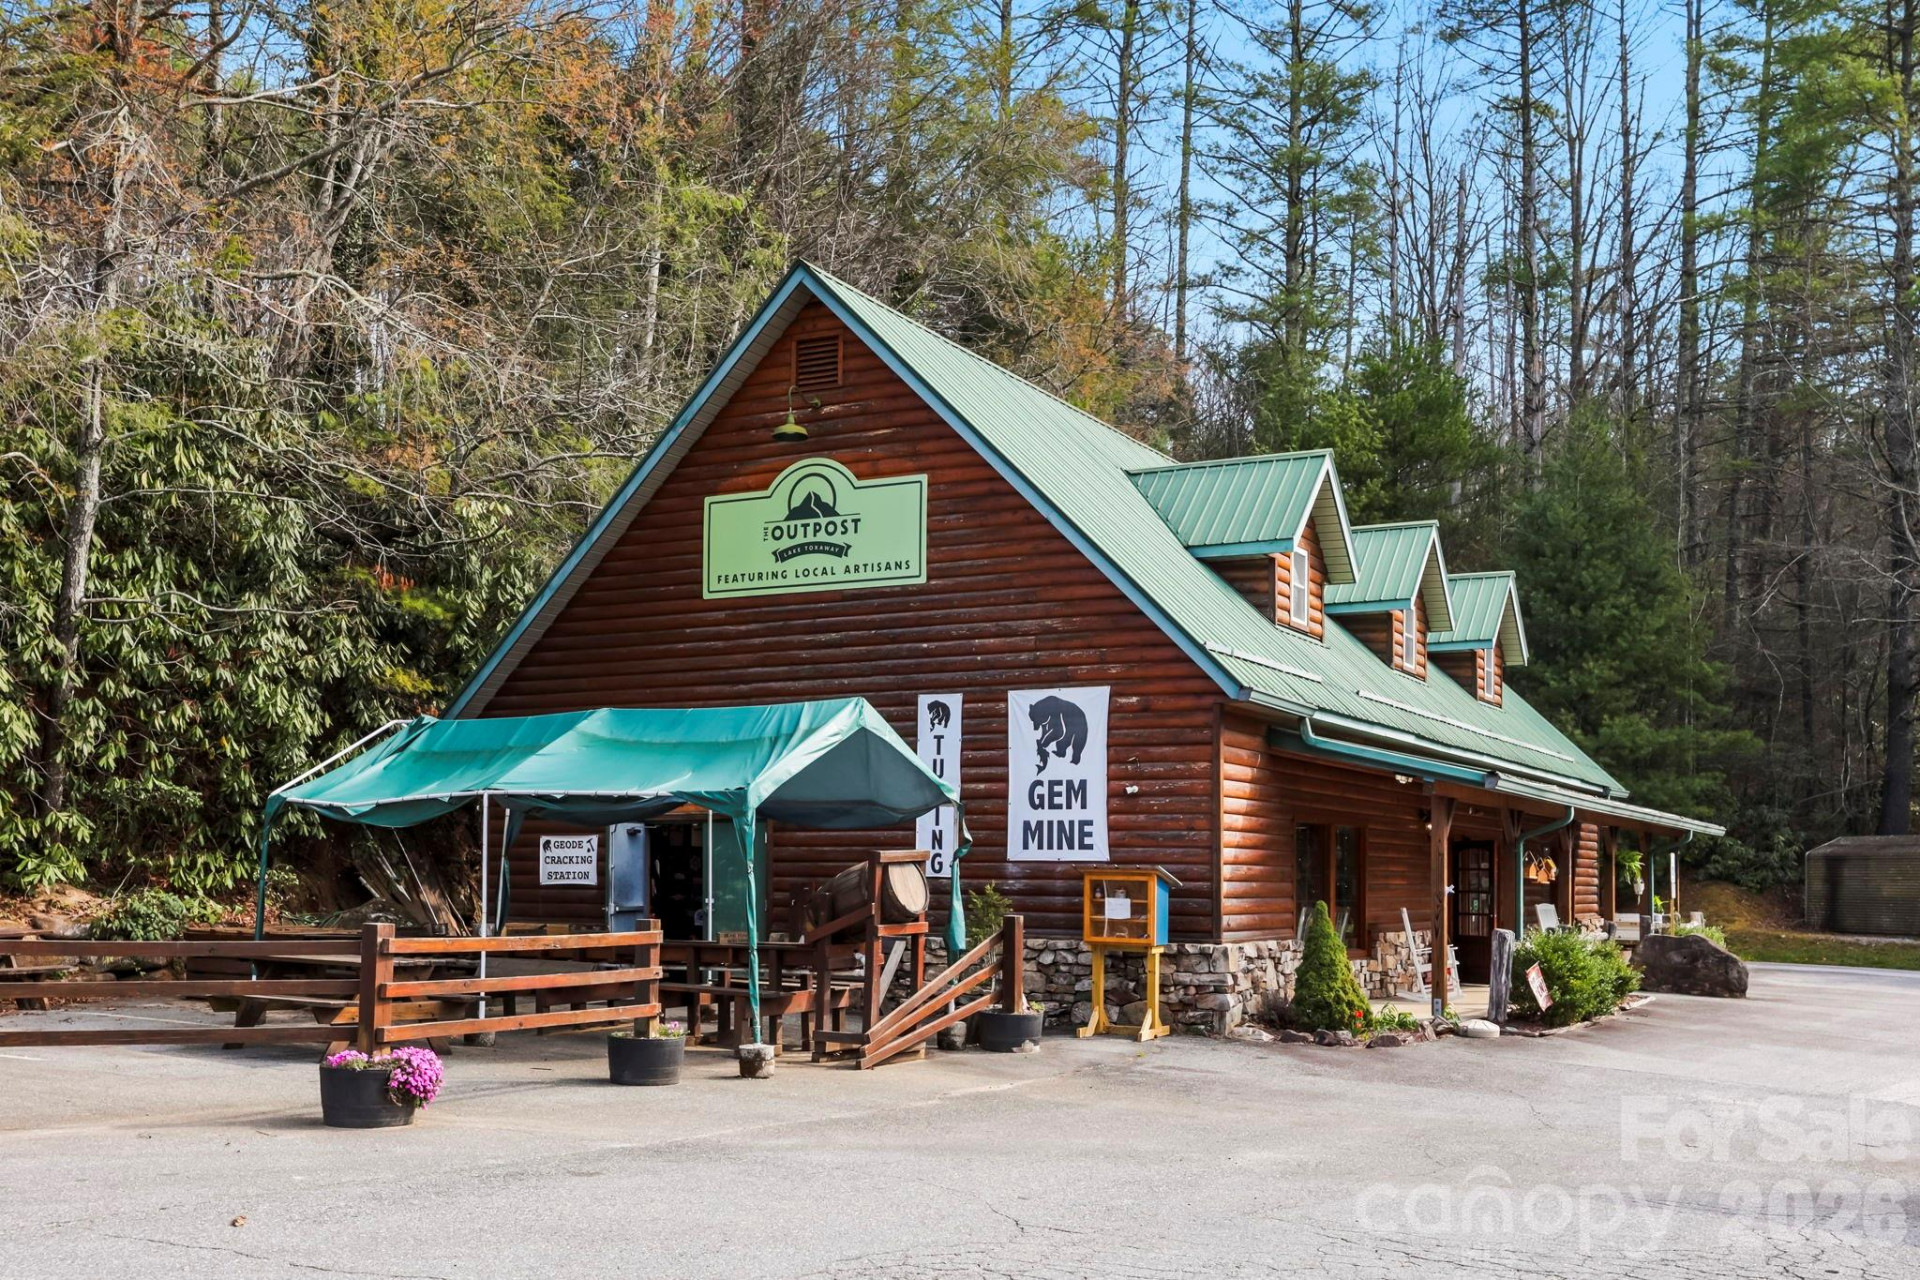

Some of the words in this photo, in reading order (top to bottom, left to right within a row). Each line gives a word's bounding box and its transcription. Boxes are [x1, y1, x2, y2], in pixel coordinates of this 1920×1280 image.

[771, 518, 861, 541] OUTPOST
[783, 547, 801, 557] LAKE
[804, 545, 840, 554] TOXAWAY
[717, 570, 788, 584] FEATURING
[795, 566, 836, 578] LOCAL
[843, 560, 911, 574] ARTISANS
[931, 735, 945, 874] TUING
[1028, 779, 1087, 810] GEM
[553, 840, 584, 849] GEODE
[1022, 819, 1094, 851] MINE
[544, 856, 593, 864] CRACKING
[547, 871, 590, 880] STATION
